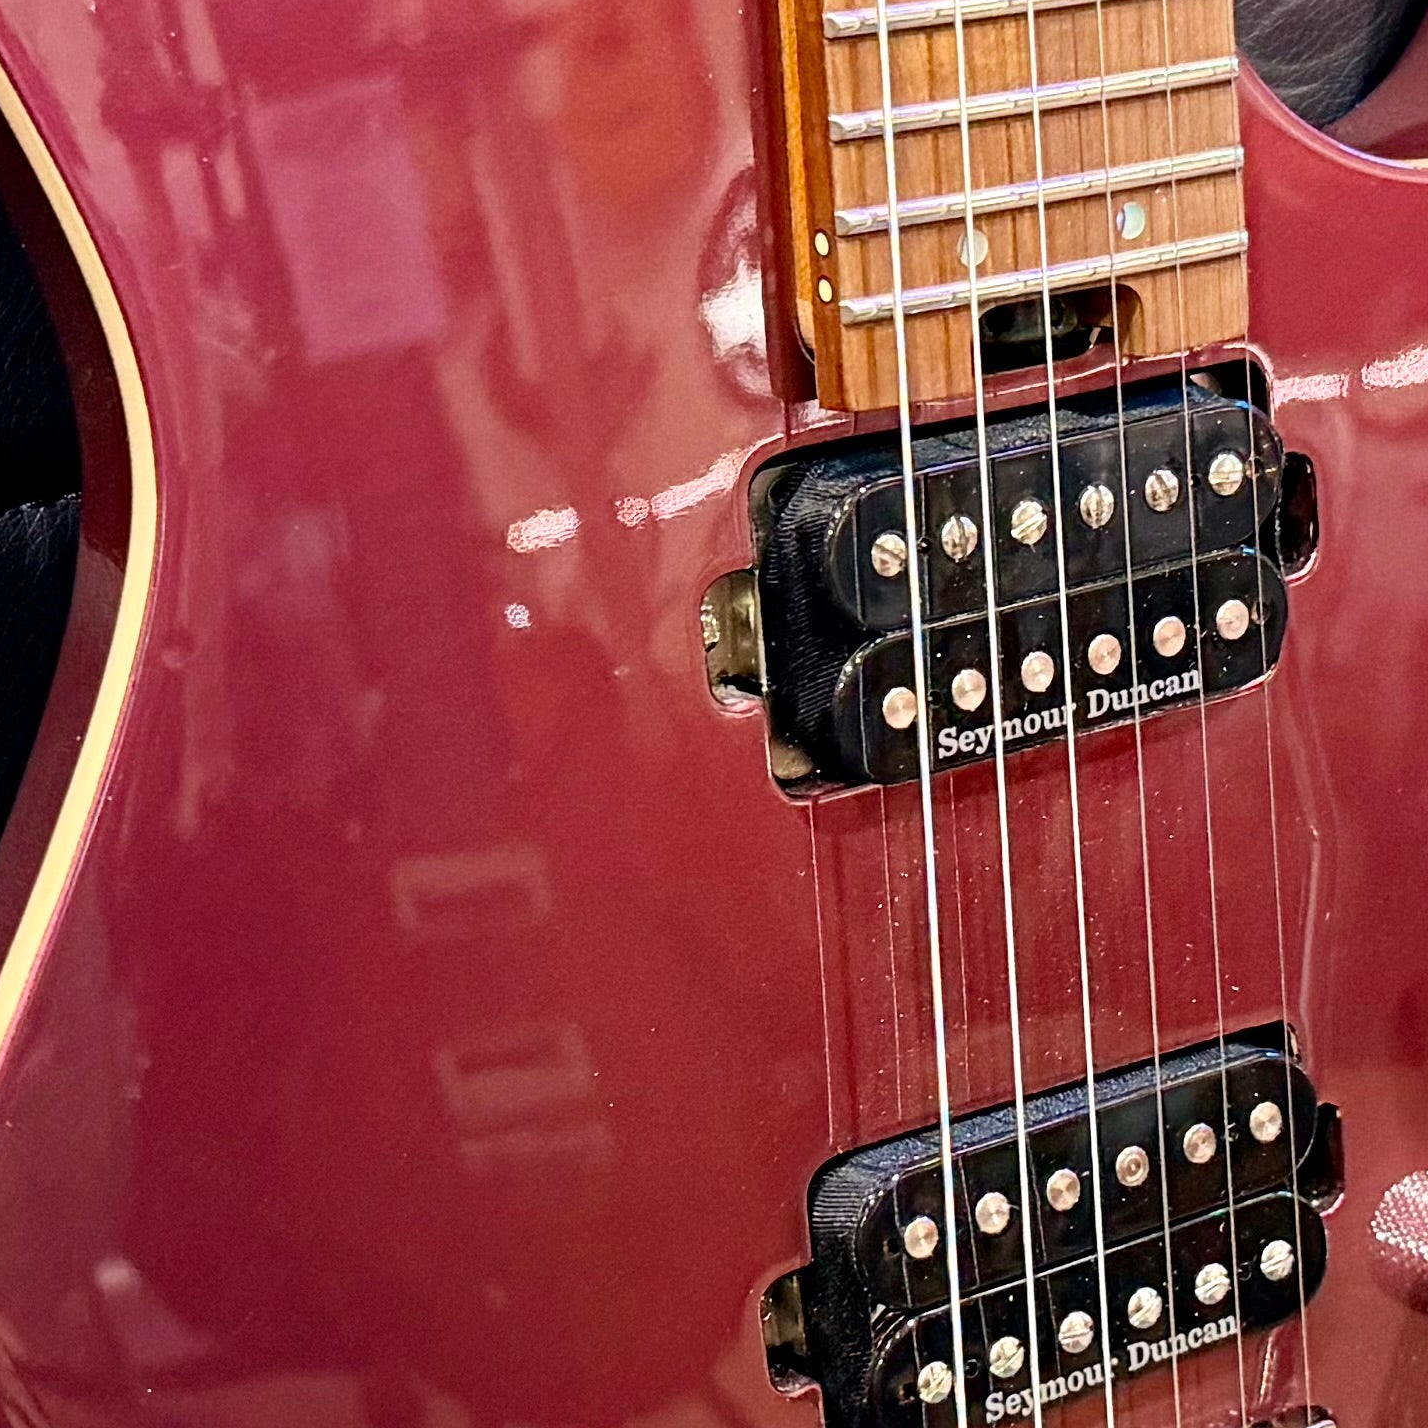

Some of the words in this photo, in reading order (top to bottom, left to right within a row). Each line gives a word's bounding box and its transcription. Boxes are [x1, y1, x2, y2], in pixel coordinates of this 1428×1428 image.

[938, 704, 1076, 759] Seymour
[1087, 669, 1200, 718] Duncan
[1128, 1315, 1237, 1371] Duncan
